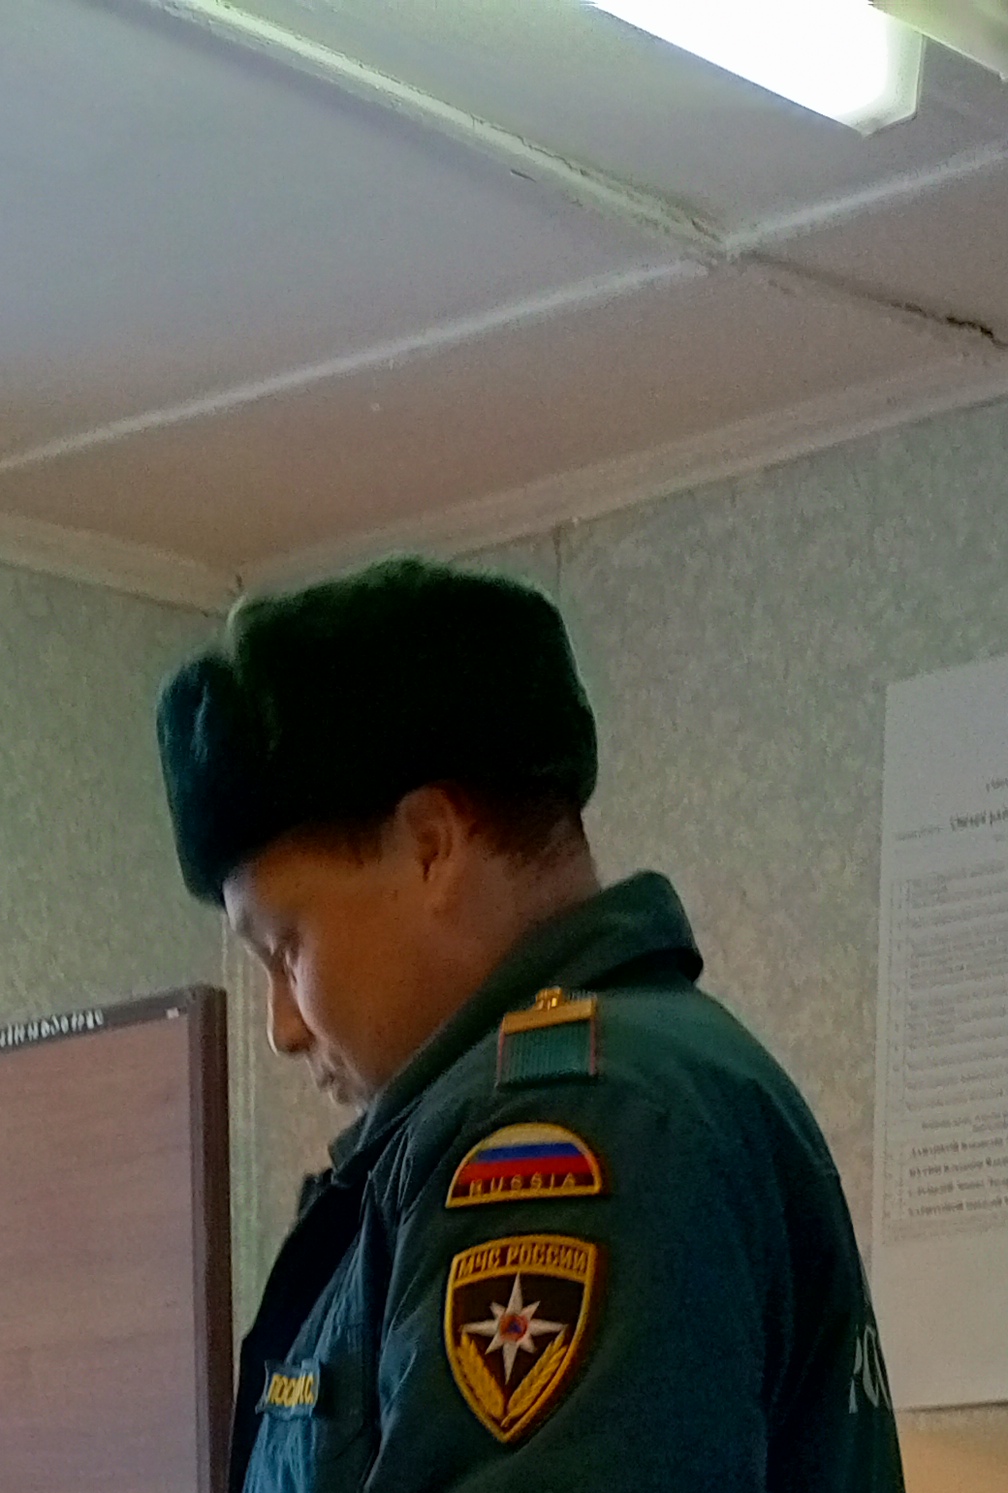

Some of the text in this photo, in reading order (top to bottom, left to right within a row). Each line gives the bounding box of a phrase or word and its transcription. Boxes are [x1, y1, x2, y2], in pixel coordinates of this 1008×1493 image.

[469, 1171, 576, 1198] RUSSIA
[456, 1241, 589, 1280] МЧС РОССИИ
